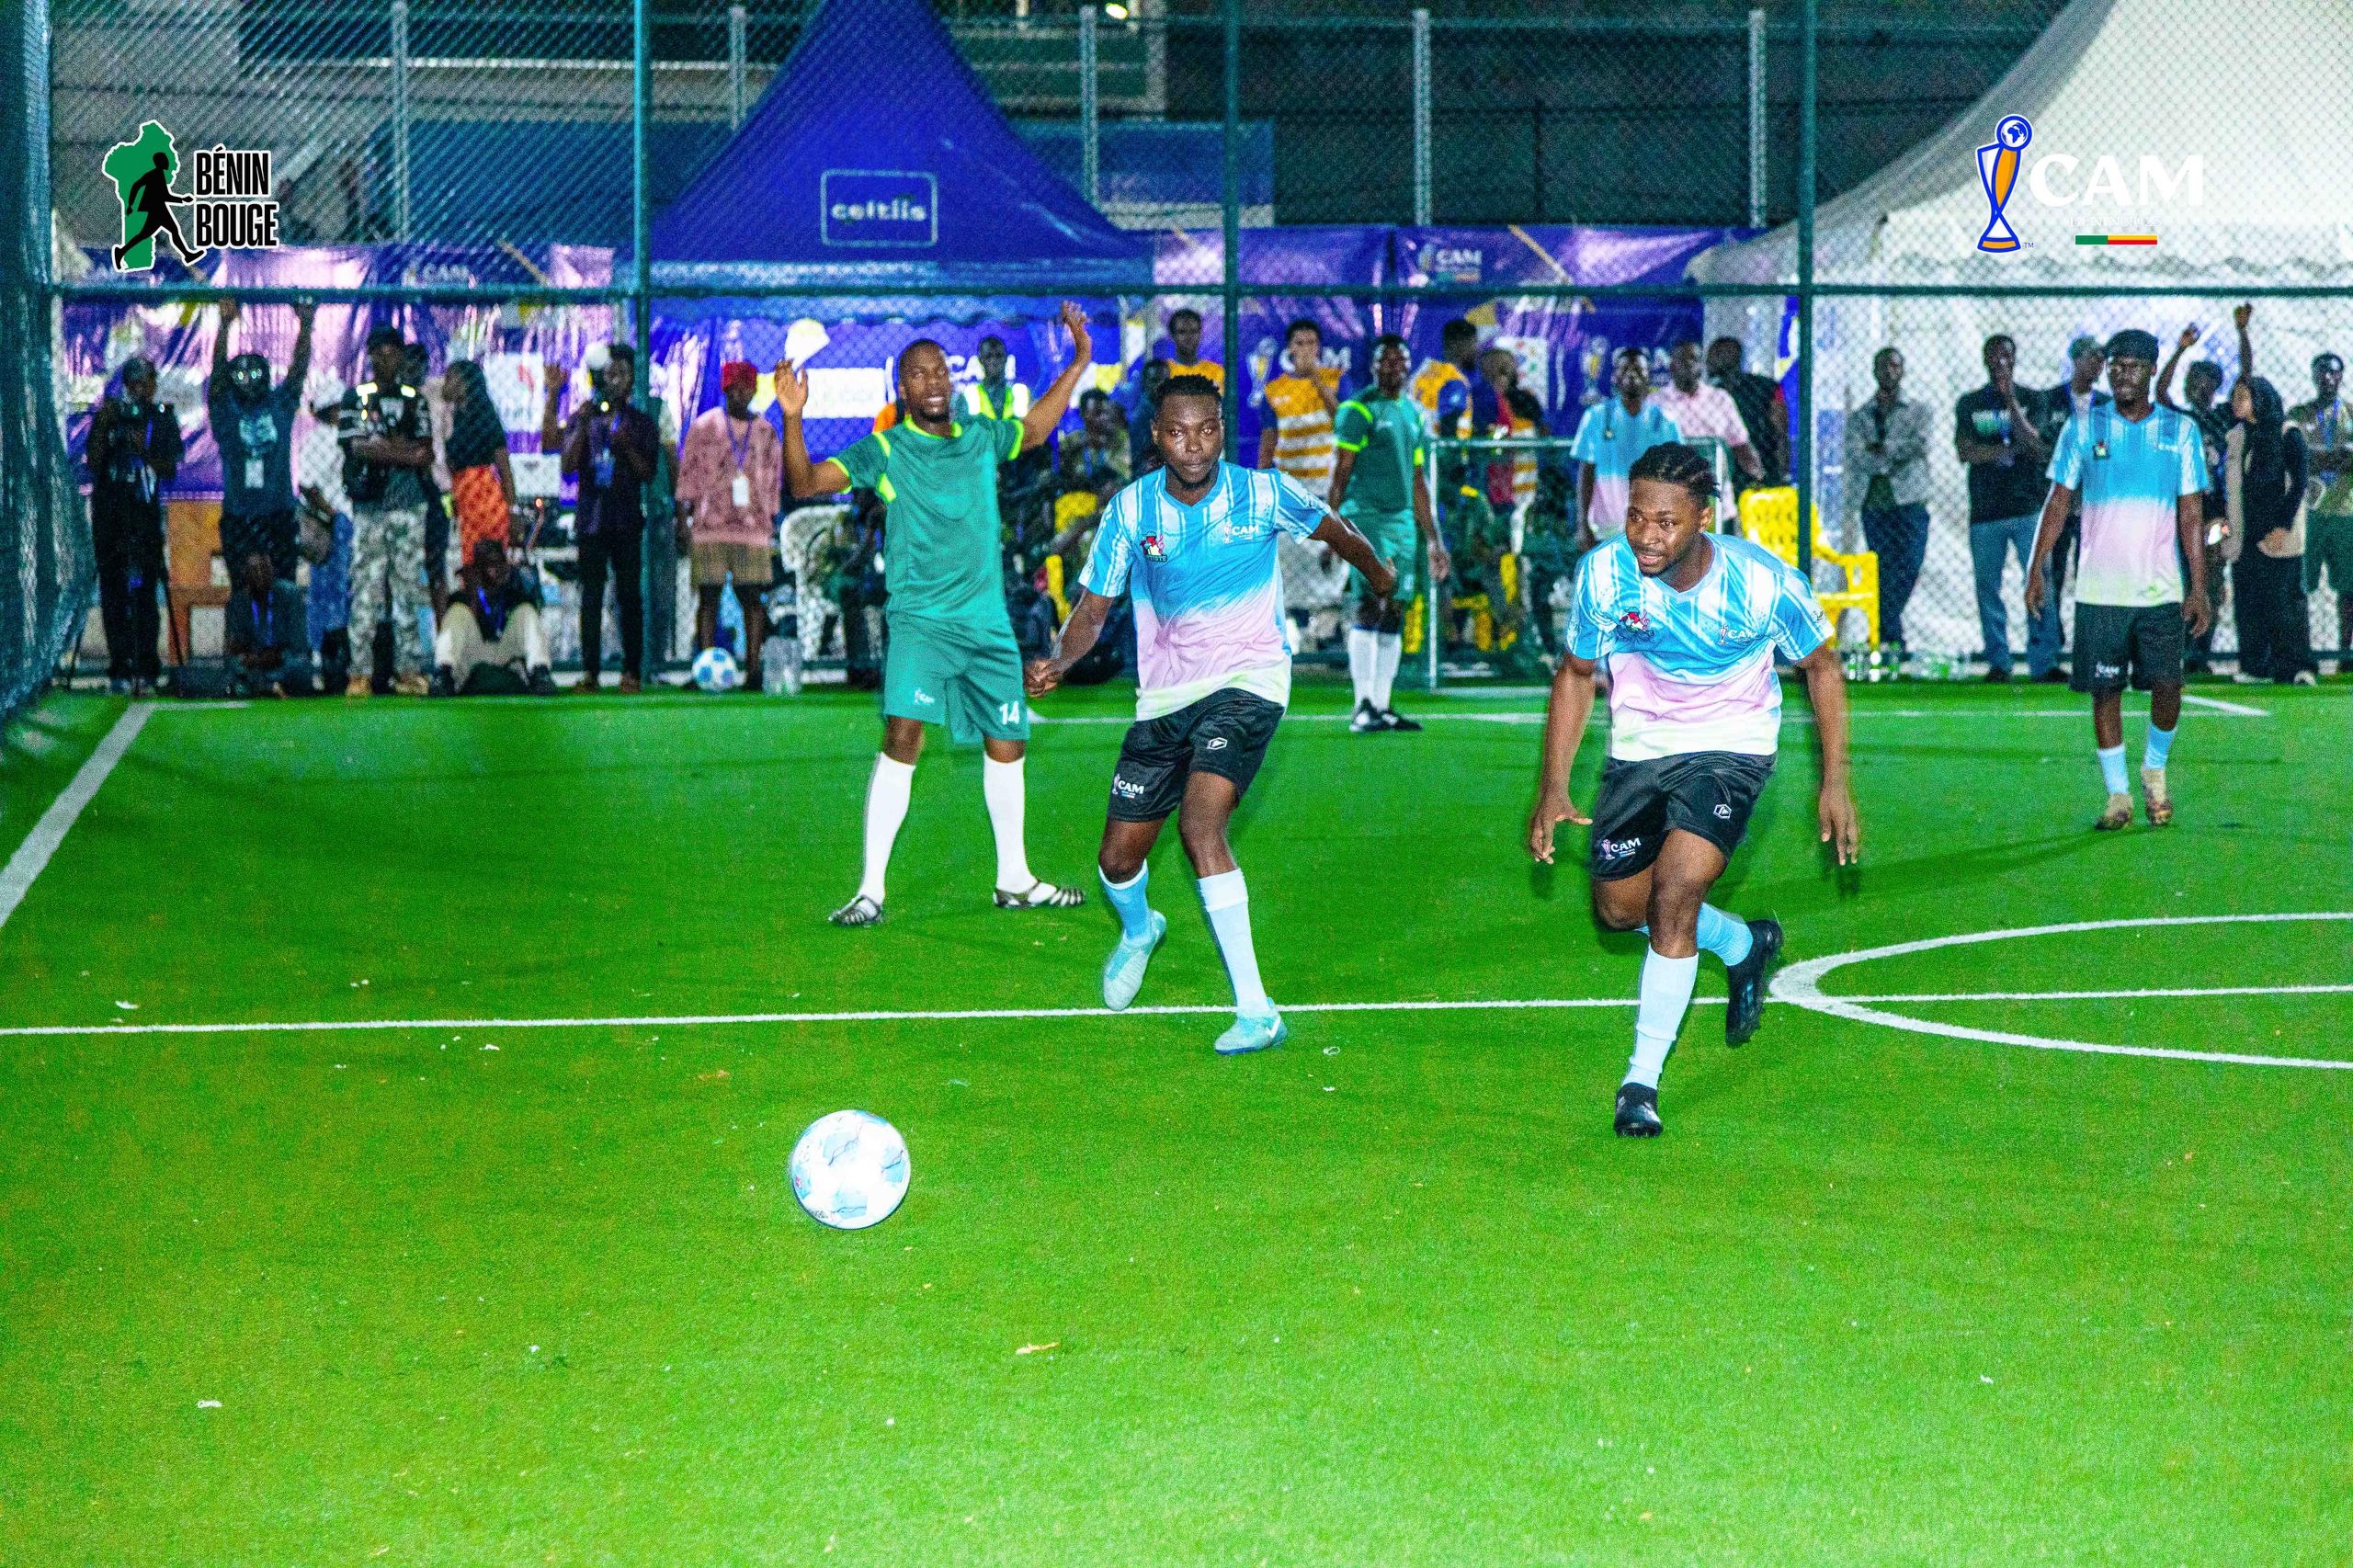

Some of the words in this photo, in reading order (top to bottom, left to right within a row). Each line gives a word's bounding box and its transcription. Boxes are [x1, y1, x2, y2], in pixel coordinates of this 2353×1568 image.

[1436, 248, 1483, 266] CAM
[1233, 524, 1259, 536] CAM
[999, 700, 1020, 725] 14
[1118, 779, 1145, 795] CAM
[1610, 837, 1642, 853] CAM
